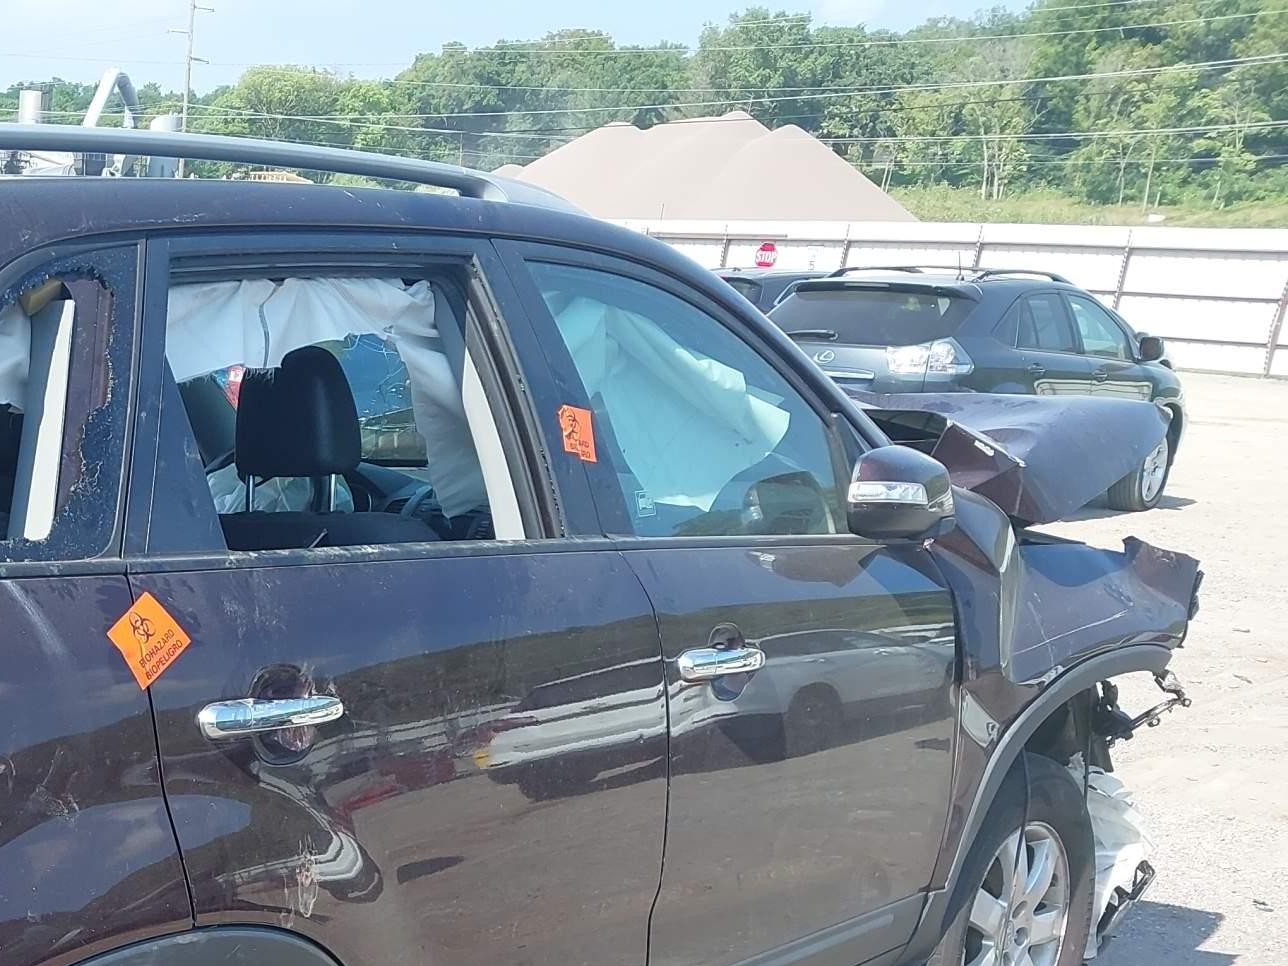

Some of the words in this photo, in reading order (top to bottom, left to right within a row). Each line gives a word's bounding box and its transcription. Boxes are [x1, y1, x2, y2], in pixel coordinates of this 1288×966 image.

[756, 251, 778, 263] STOP
[138, 628, 175, 669] BIOHAZARD
[144, 639, 183, 681] BIOPELIGRO
